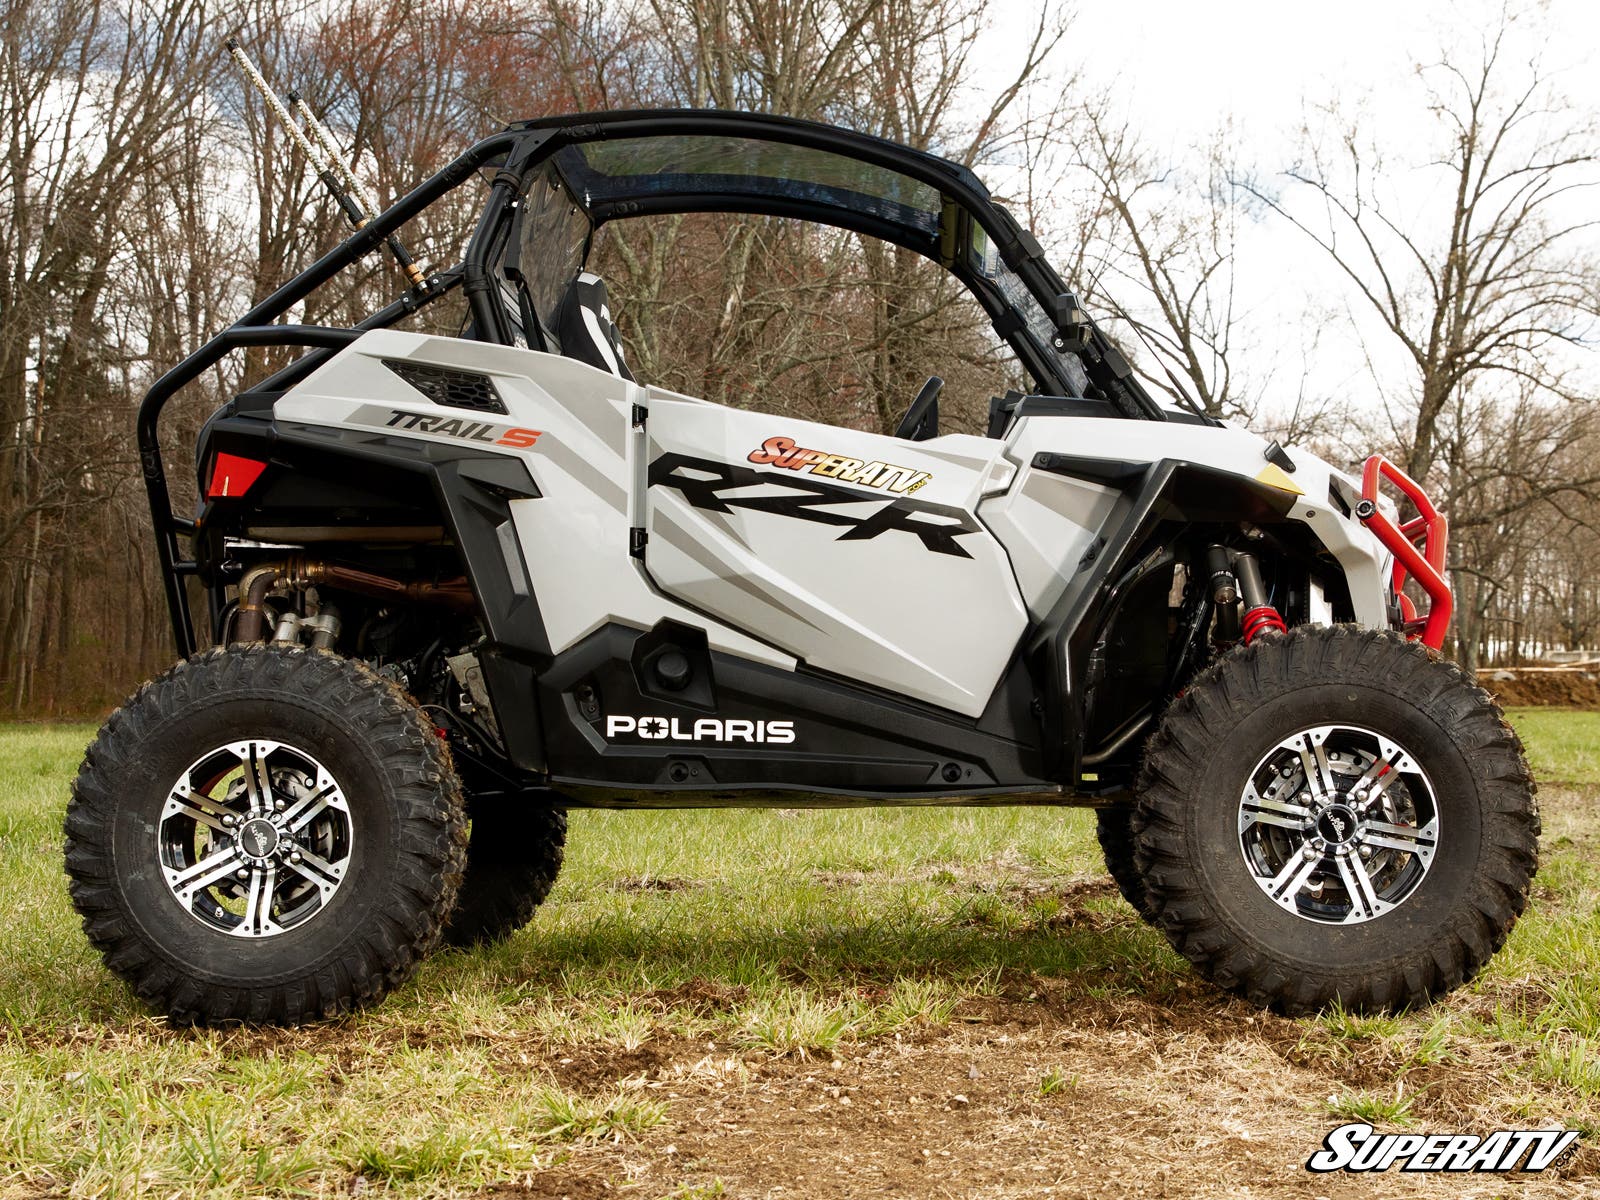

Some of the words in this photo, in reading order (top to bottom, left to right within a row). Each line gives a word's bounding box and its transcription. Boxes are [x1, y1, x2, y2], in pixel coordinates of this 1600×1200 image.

[386, 410, 494, 442] TRAIL
[496, 427, 542, 448] S
[747, 436, 931, 493] SUPERATV
[648, 452, 983, 559] RZR
[606, 715, 796, 744] POLARIS
